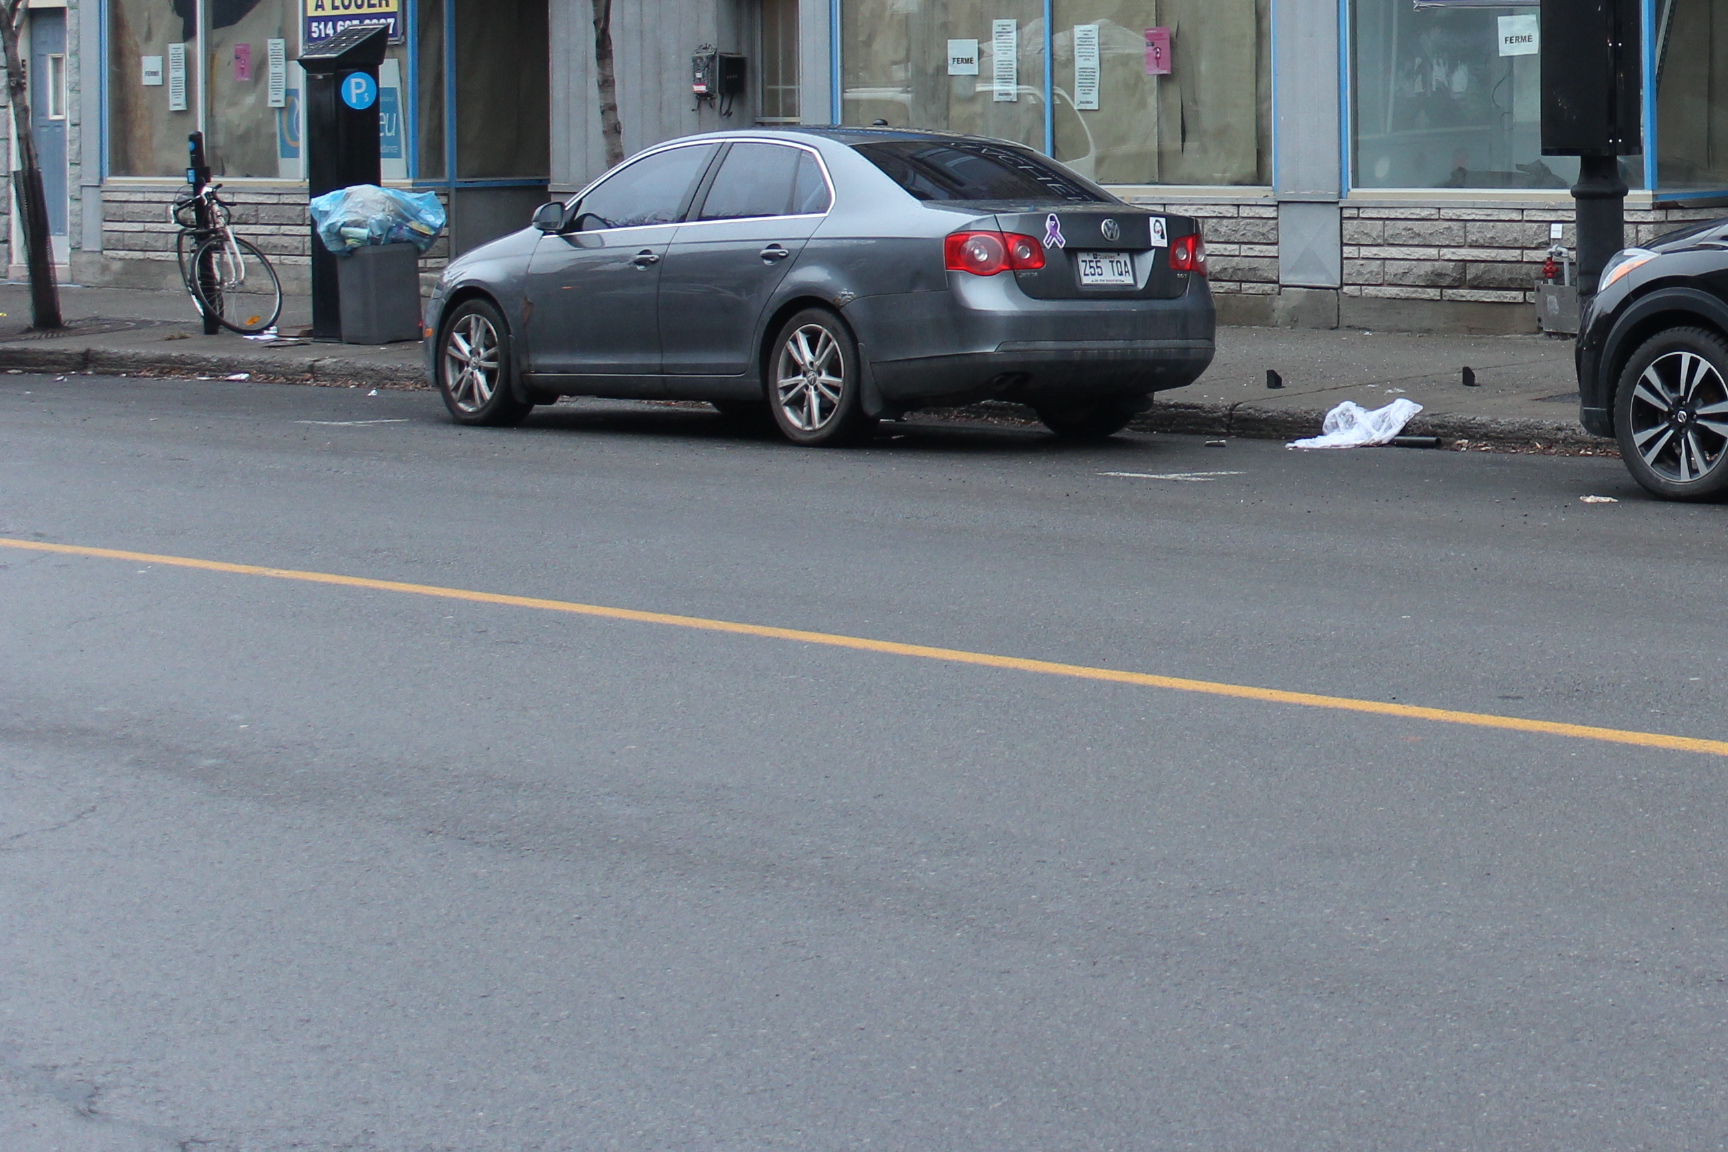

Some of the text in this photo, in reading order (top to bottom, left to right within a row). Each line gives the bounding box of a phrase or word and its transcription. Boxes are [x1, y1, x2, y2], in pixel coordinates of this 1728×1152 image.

[311, 21, 334, 38] 514
[1504, 33, 1533, 45] FERMÉ
[952, 56, 974, 65] FERMÉ
[1081, 259, 1131, 276] Z55 TQA
